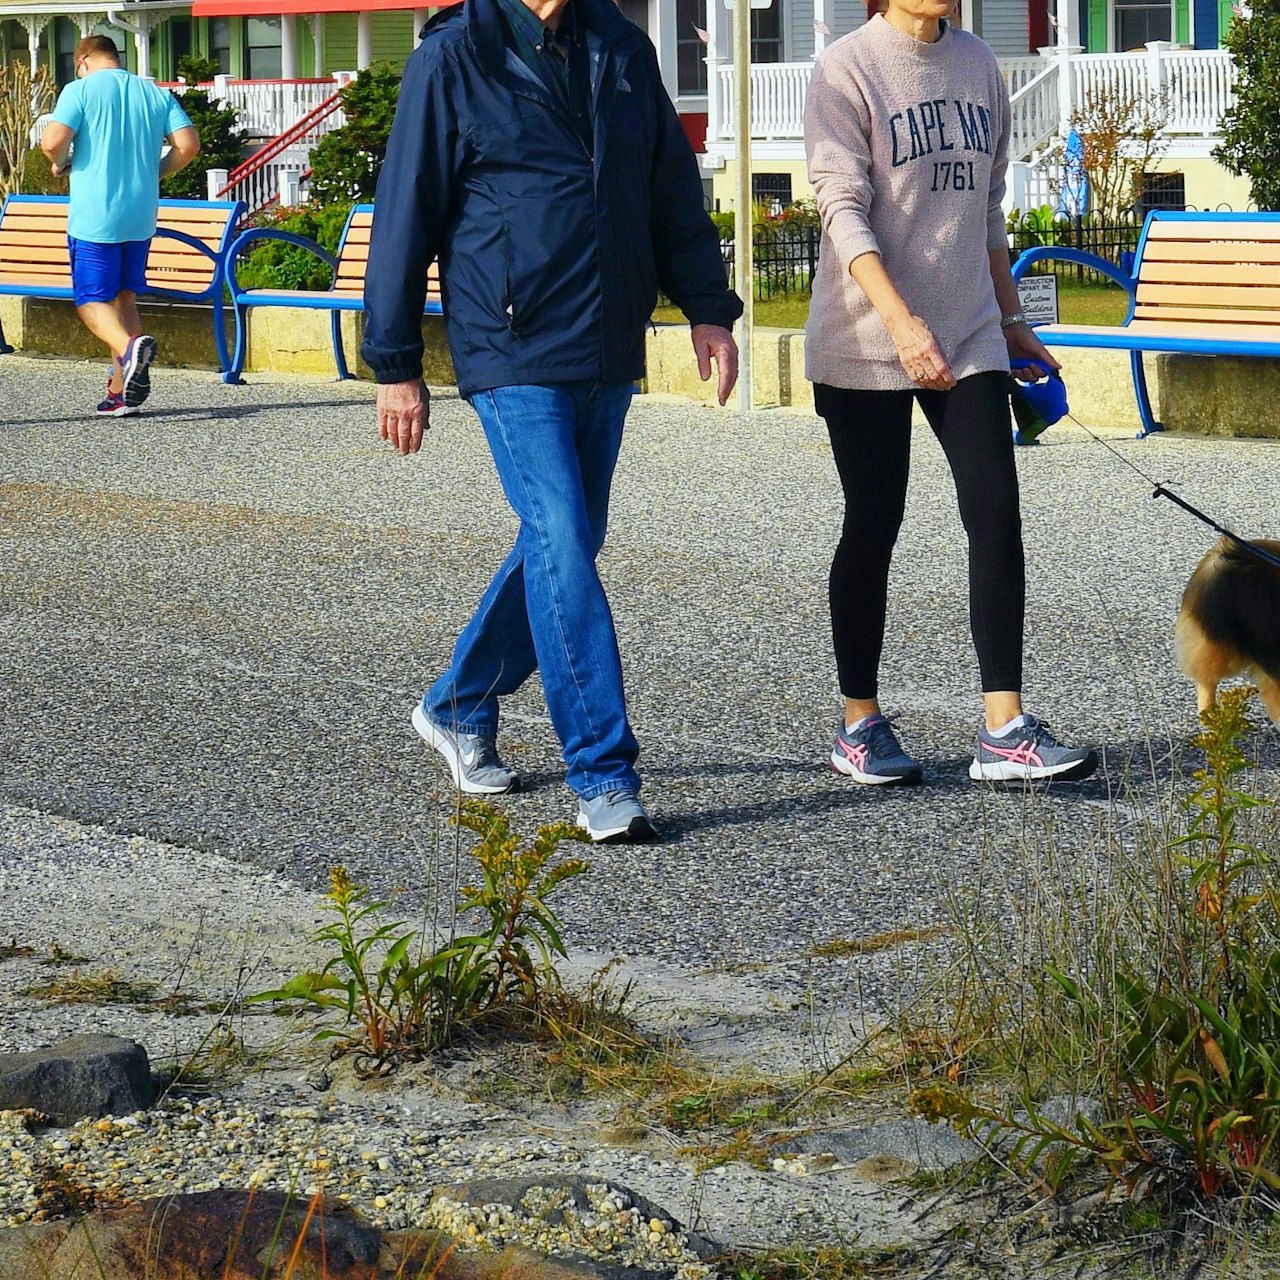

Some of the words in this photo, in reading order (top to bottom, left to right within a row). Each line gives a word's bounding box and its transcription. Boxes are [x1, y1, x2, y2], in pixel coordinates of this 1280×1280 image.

[889, 99, 954, 168] CAPE
[954, 100, 992, 157] MA
[931, 161, 975, 192] 1761
